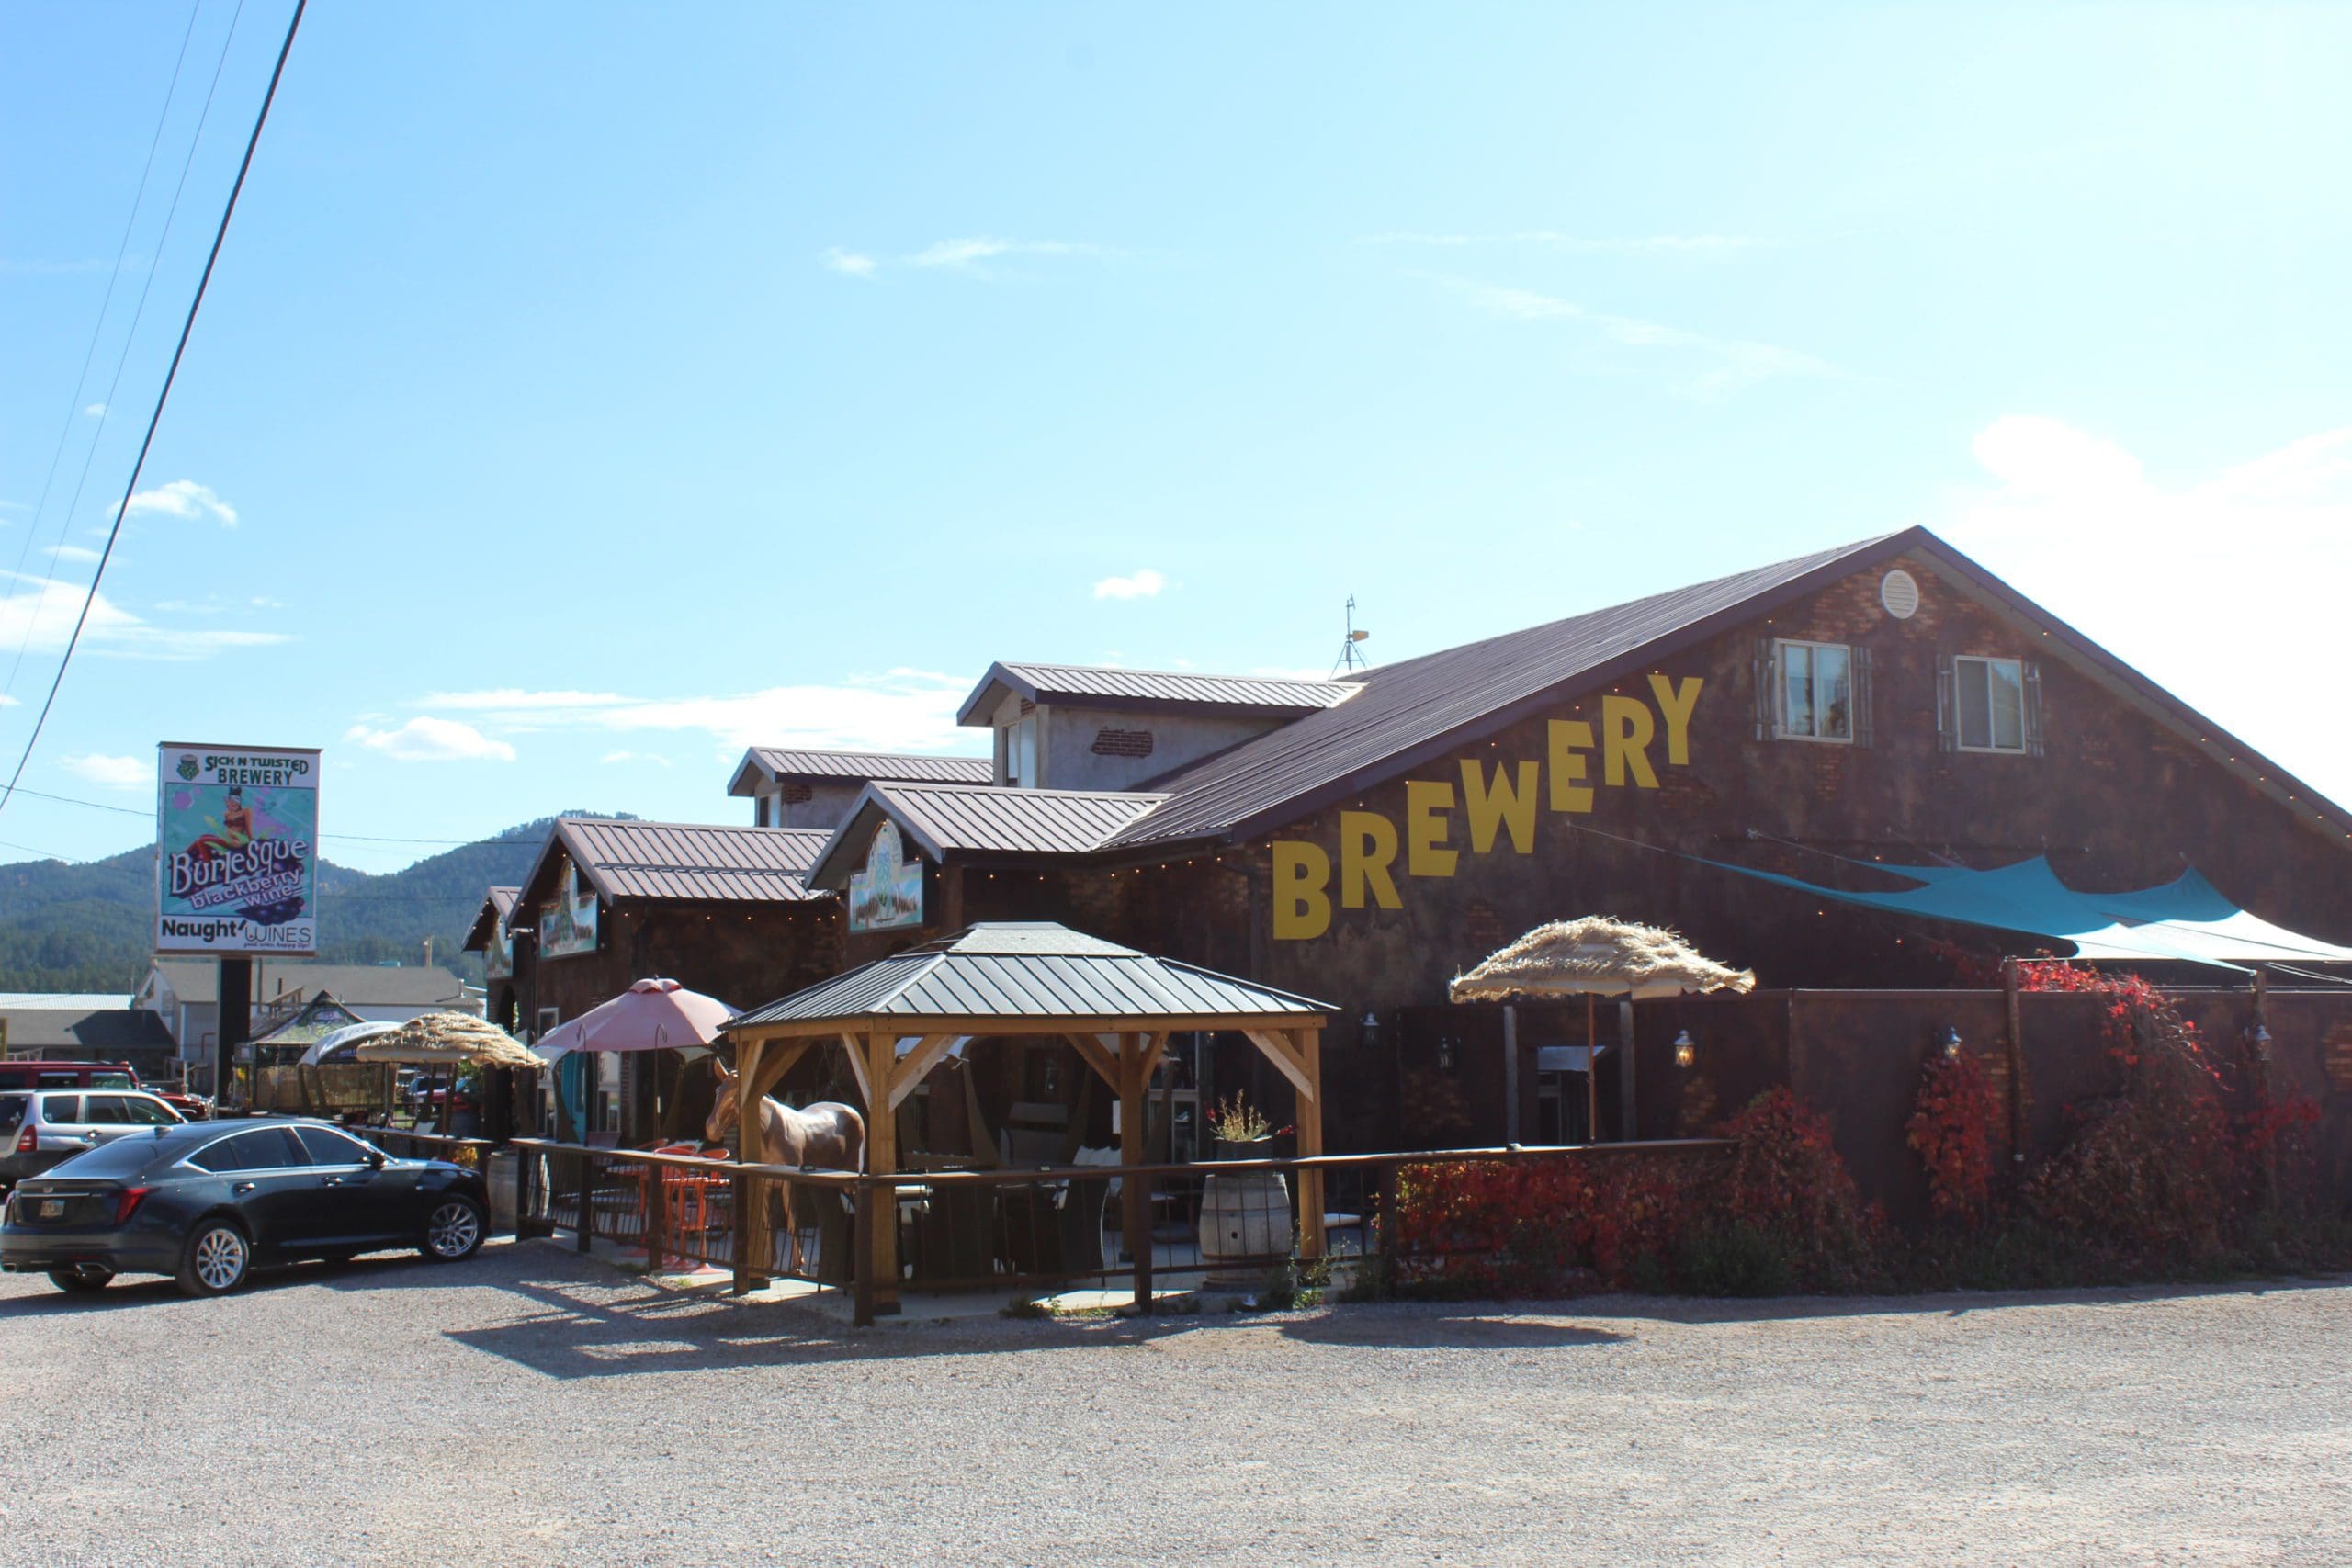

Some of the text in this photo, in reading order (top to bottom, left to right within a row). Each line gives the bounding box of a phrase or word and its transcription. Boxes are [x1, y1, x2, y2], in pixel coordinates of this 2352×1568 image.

[204, 756, 308, 775] SICK N TWISTED
[218, 768, 293, 786] BREWERY
[1272, 674, 1704, 940] BREWERY
[170, 840, 308, 894] Burlesque
[190, 868, 300, 909] blackberry
[244, 886, 293, 907] wine
[244, 926, 311, 943] WINES
